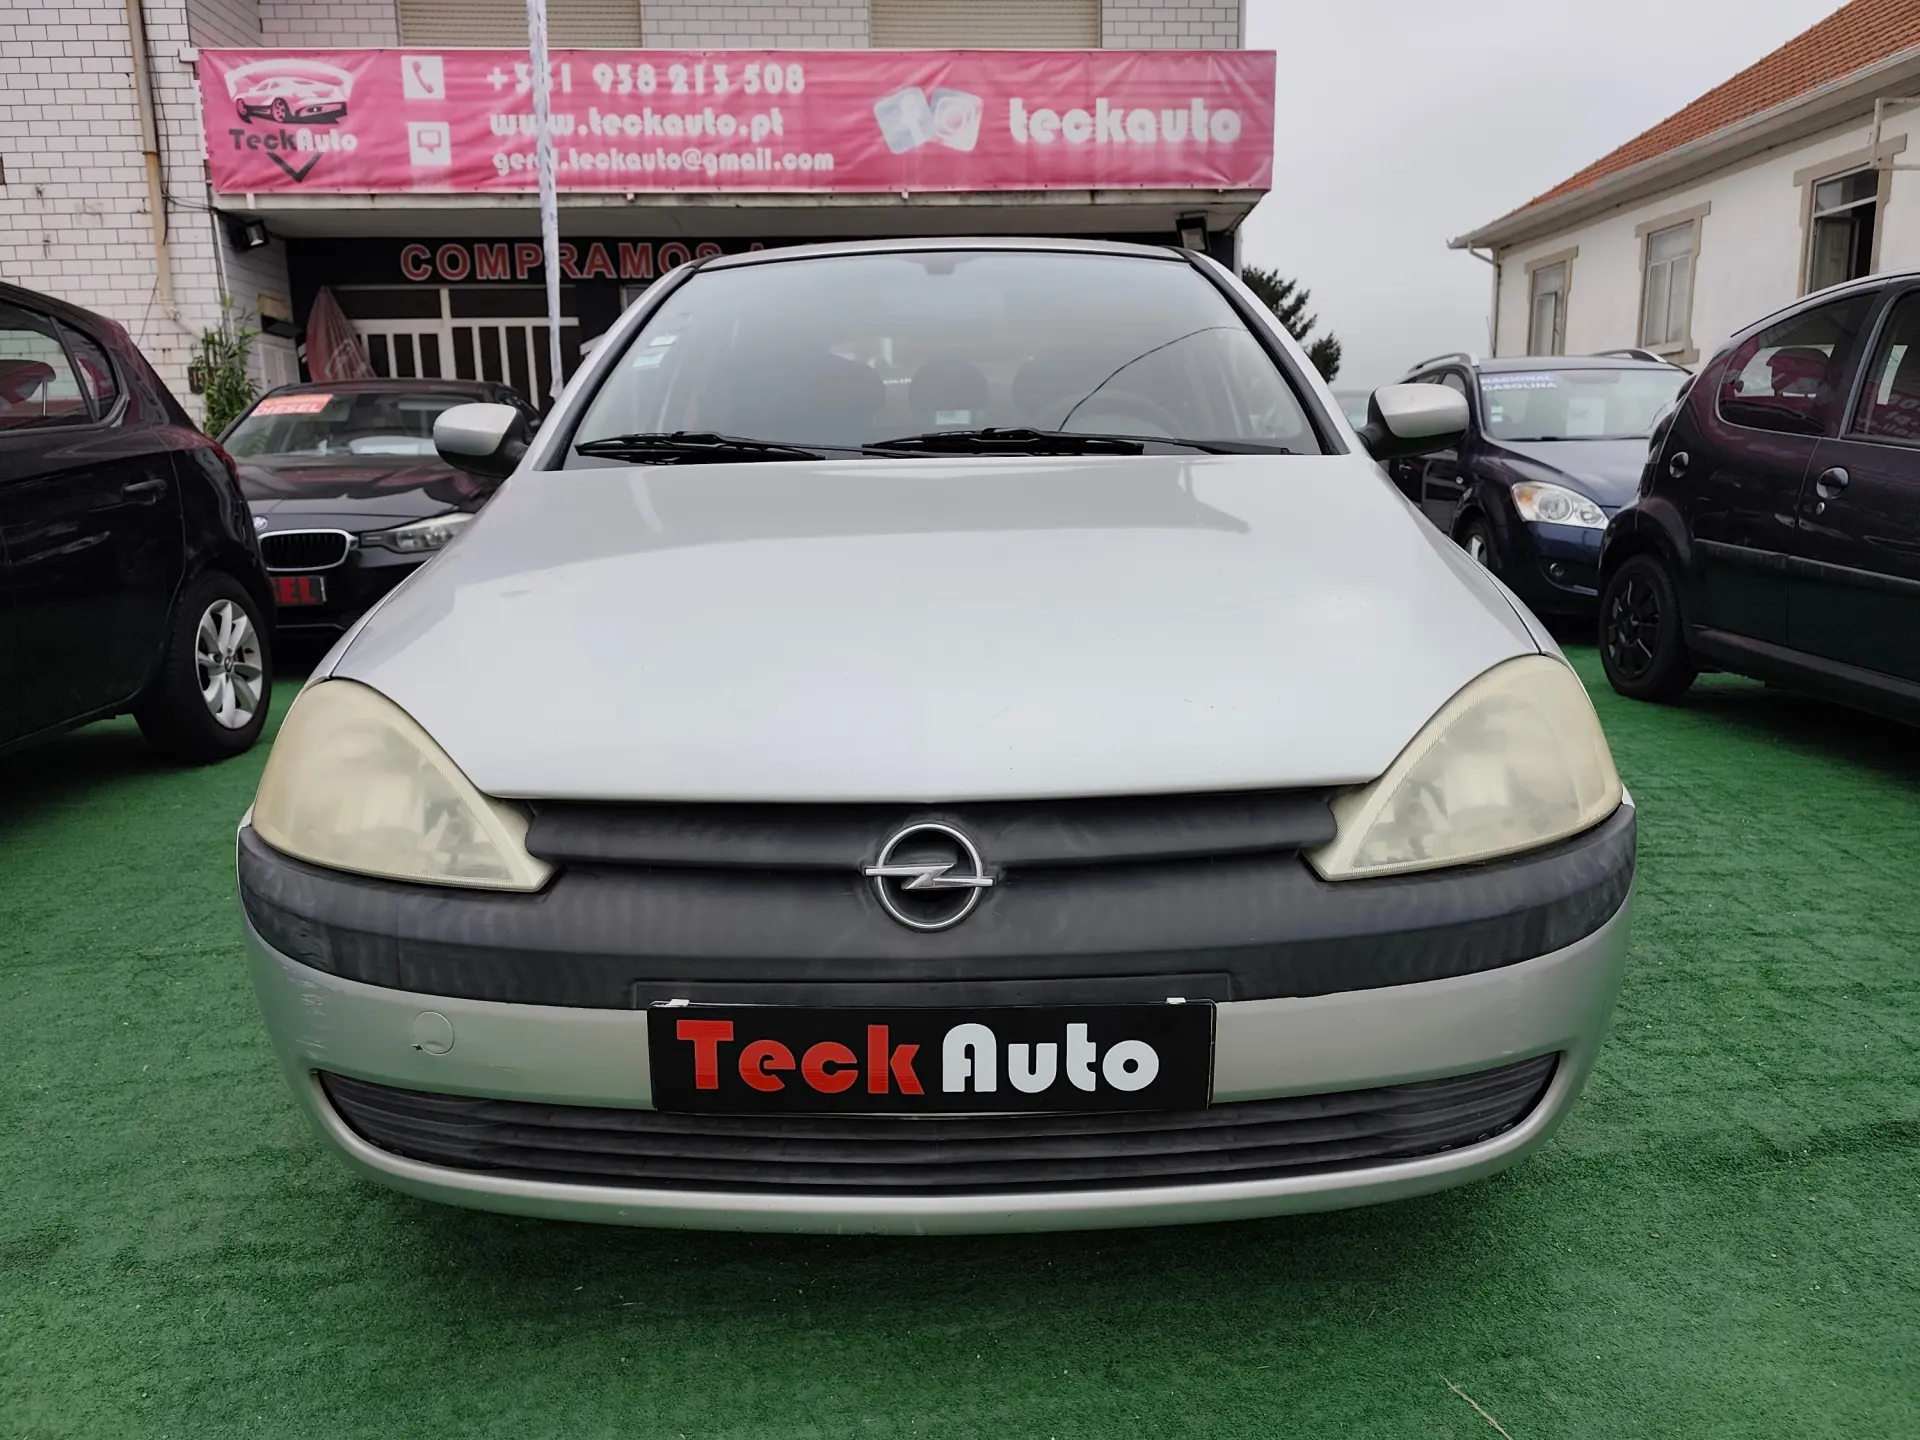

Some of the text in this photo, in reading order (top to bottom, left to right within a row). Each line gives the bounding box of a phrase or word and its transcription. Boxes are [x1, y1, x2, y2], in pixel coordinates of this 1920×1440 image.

[486, 63, 805, 94] +31 938 213 508
[1009, 97, 1242, 144] teckauto
[492, 147, 835, 178] gerl.teckauto@gmail.com
